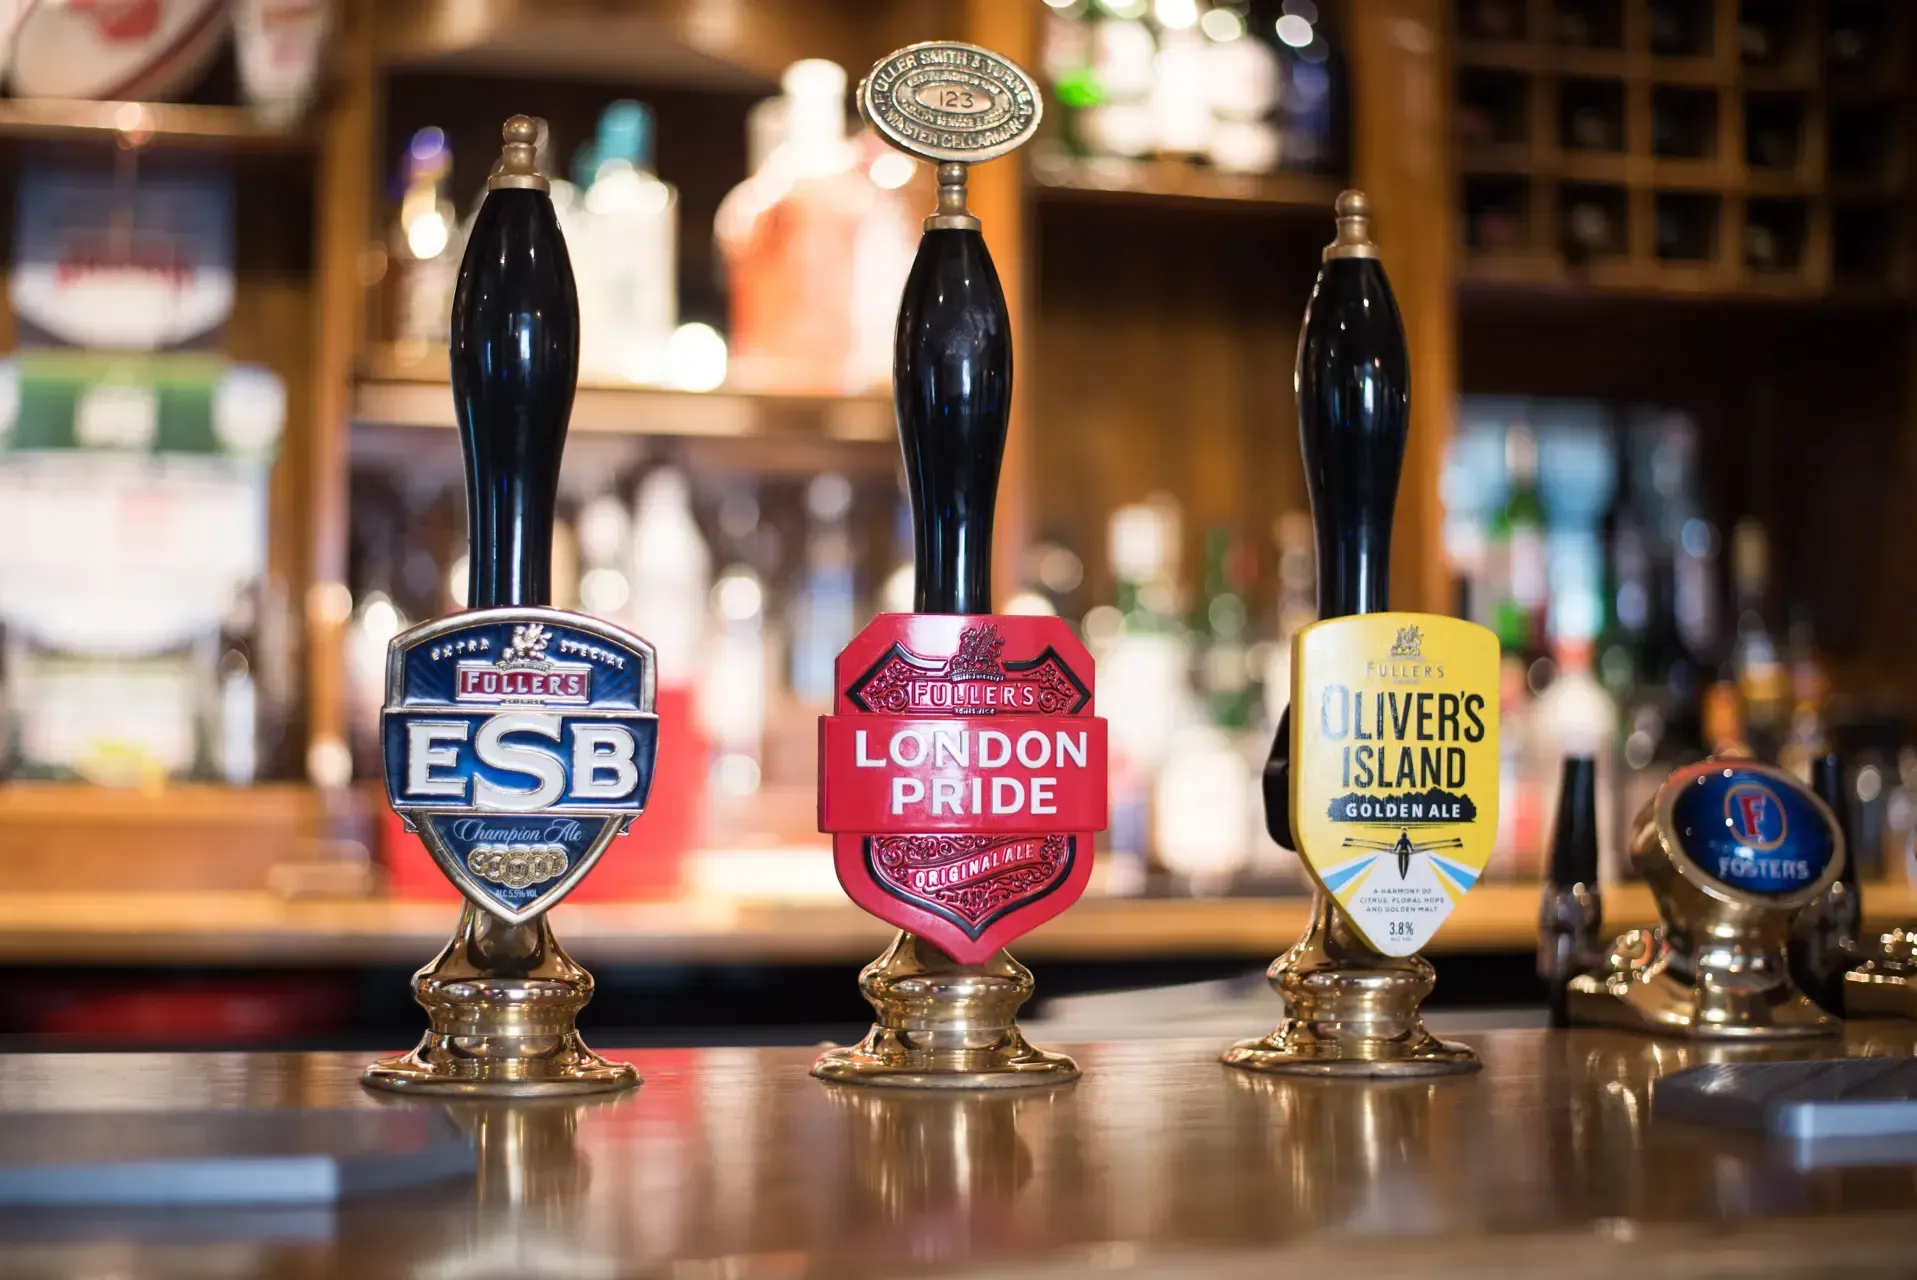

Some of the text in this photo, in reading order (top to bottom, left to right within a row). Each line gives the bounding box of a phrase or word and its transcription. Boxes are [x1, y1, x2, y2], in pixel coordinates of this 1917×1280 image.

[874, 54, 917, 104] FULLER
[920, 49, 968, 66] SMITH
[986, 59, 1033, 115] TURNER
[940, 89, 974, 109] 123
[884, 108, 938, 146] MASTER
[941, 118, 1024, 149] CELLARMAN
[430, 638, 626, 671] EXTRA SPECIAL
[466, 671, 581, 697] FULLER'S
[913, 681, 1034, 707] FULLER'S
[1321, 684, 1485, 744] OLIVER'S
[405, 713, 639, 811] ESB
[855, 730, 1088, 769] LONDON
[1341, 744, 1466, 789] ISLAND
[891, 777, 1058, 815] PRIDE
[1345, 801, 1461, 819] GOLDEN ALE
[453, 818, 583, 847] Champion Ale
[915, 843, 1034, 888] ORIGINAL ALE
[495, 889, 538, 898] ALC 5.5% VOL
[1389, 921, 1414, 936] 3.8%
